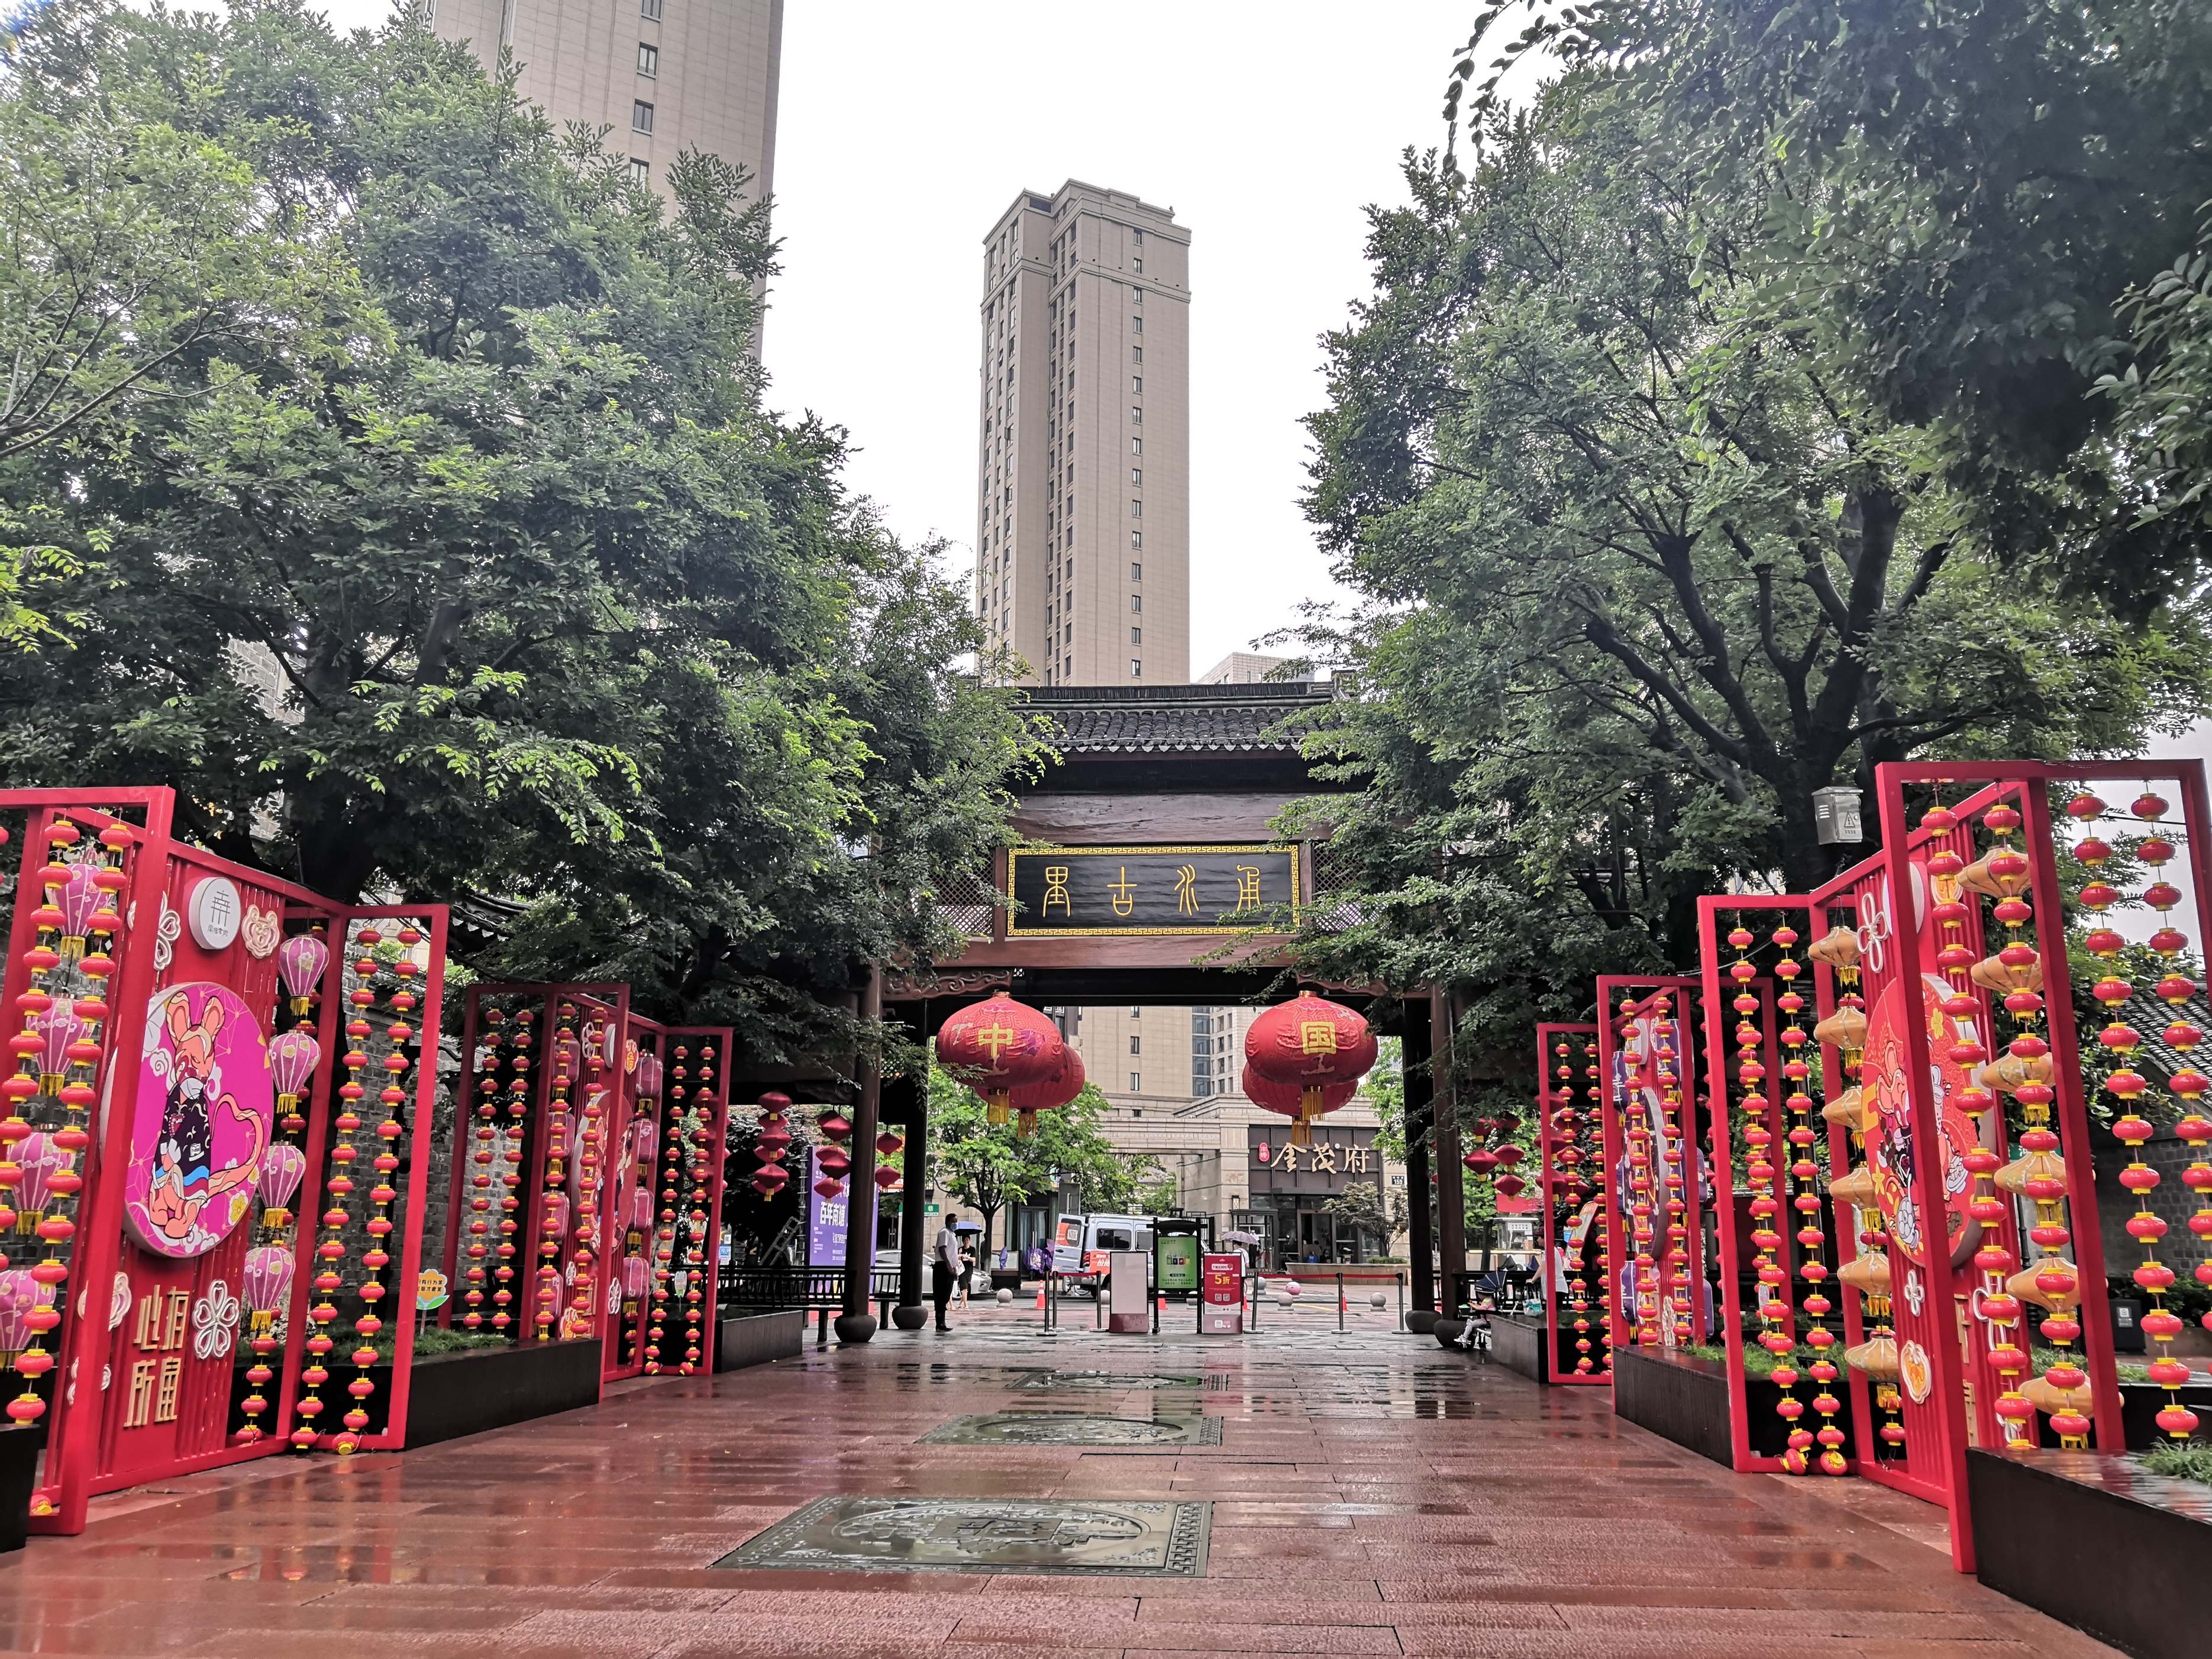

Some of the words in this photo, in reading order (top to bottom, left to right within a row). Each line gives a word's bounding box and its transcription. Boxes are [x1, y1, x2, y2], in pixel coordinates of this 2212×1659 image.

[978, 1022, 1014, 1058] 中
[1300, 1021, 1336, 1054] 国
[1270, 1141, 1371, 1174] 金茂府
[820, 1201, 846, 1227] 百年南塘
[1215, 1274, 1230, 1284] 5折
[133, 1284, 190, 1351] 心有
